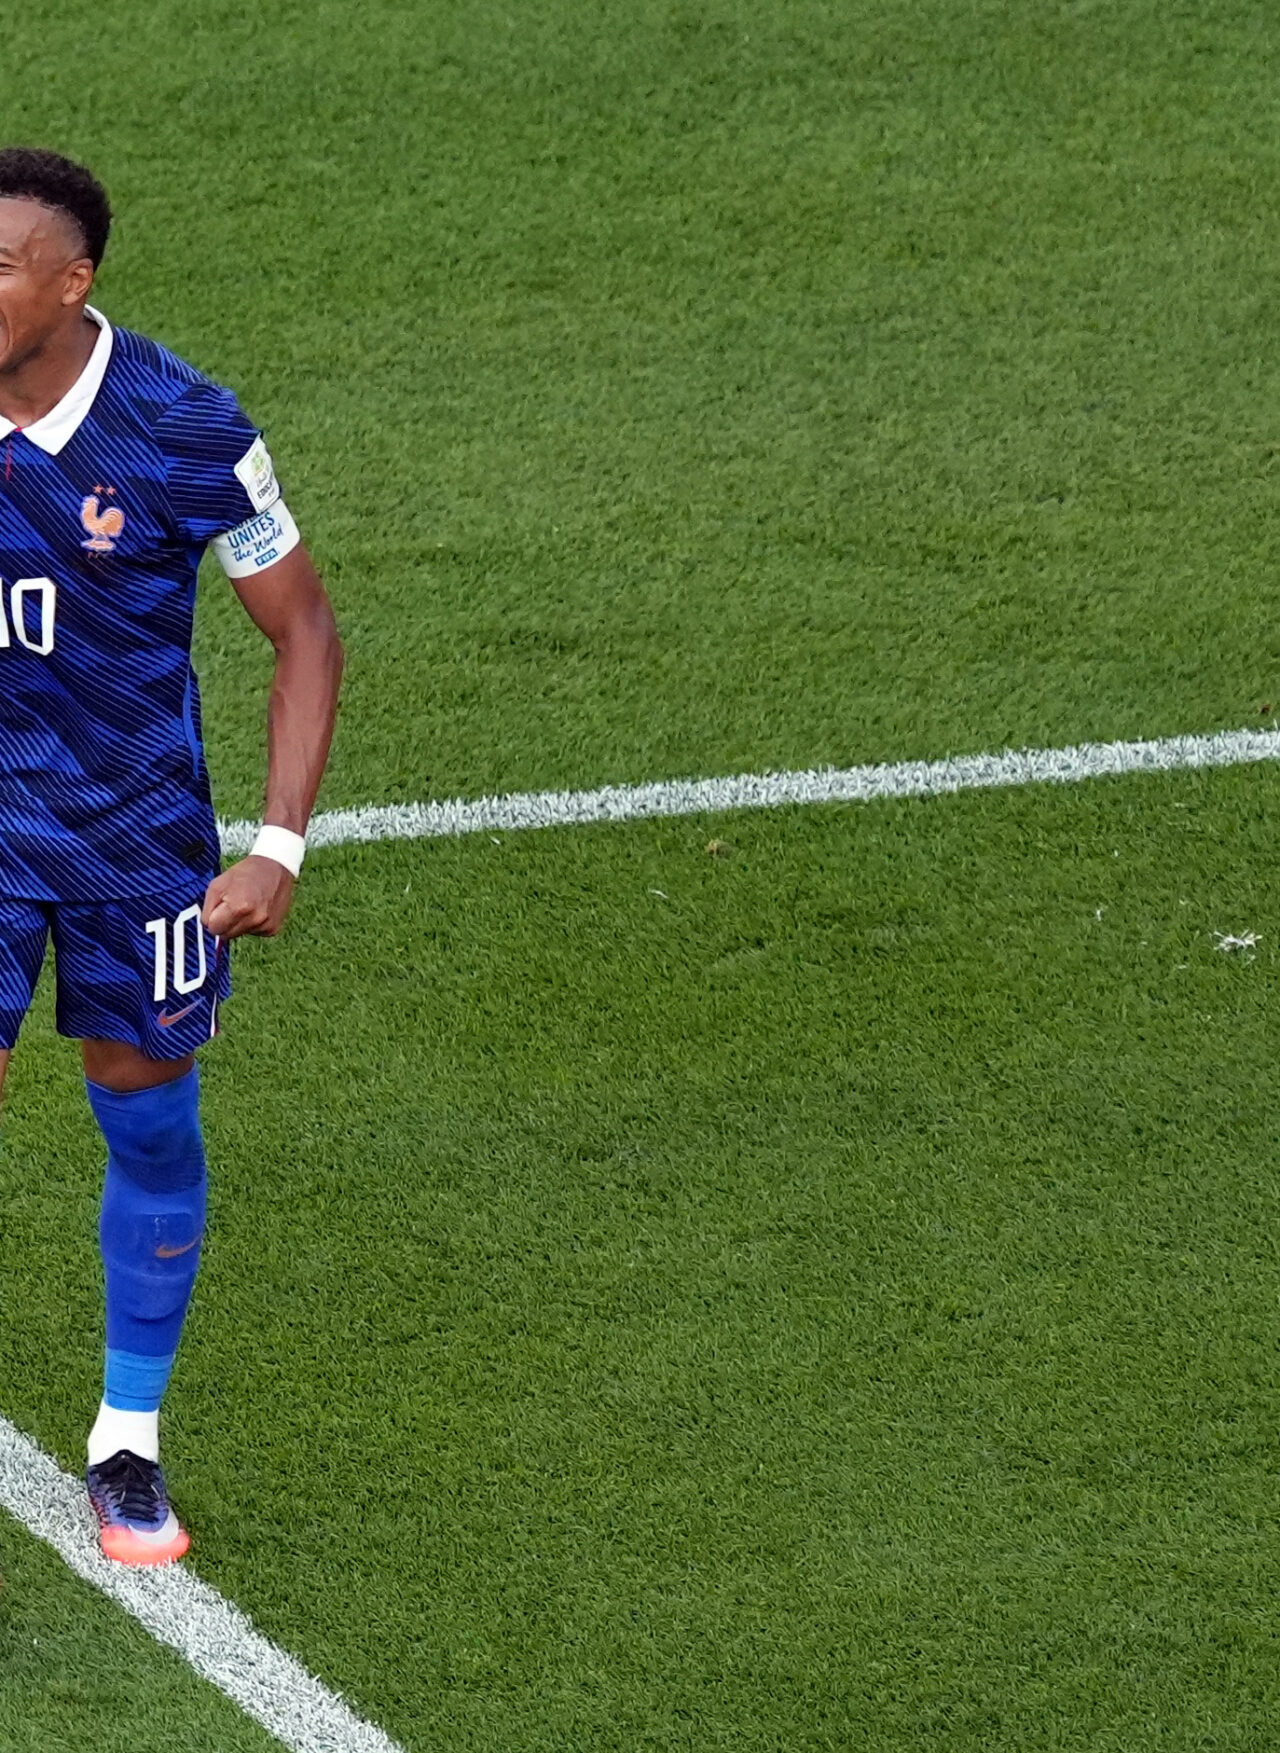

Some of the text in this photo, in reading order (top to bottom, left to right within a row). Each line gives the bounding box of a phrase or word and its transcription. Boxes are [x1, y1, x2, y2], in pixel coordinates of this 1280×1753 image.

[227, 512, 275, 548] UNITES
[232, 548, 254, 562] the
[254, 523, 284, 553] World
[145, 904, 207, 1002] 10
